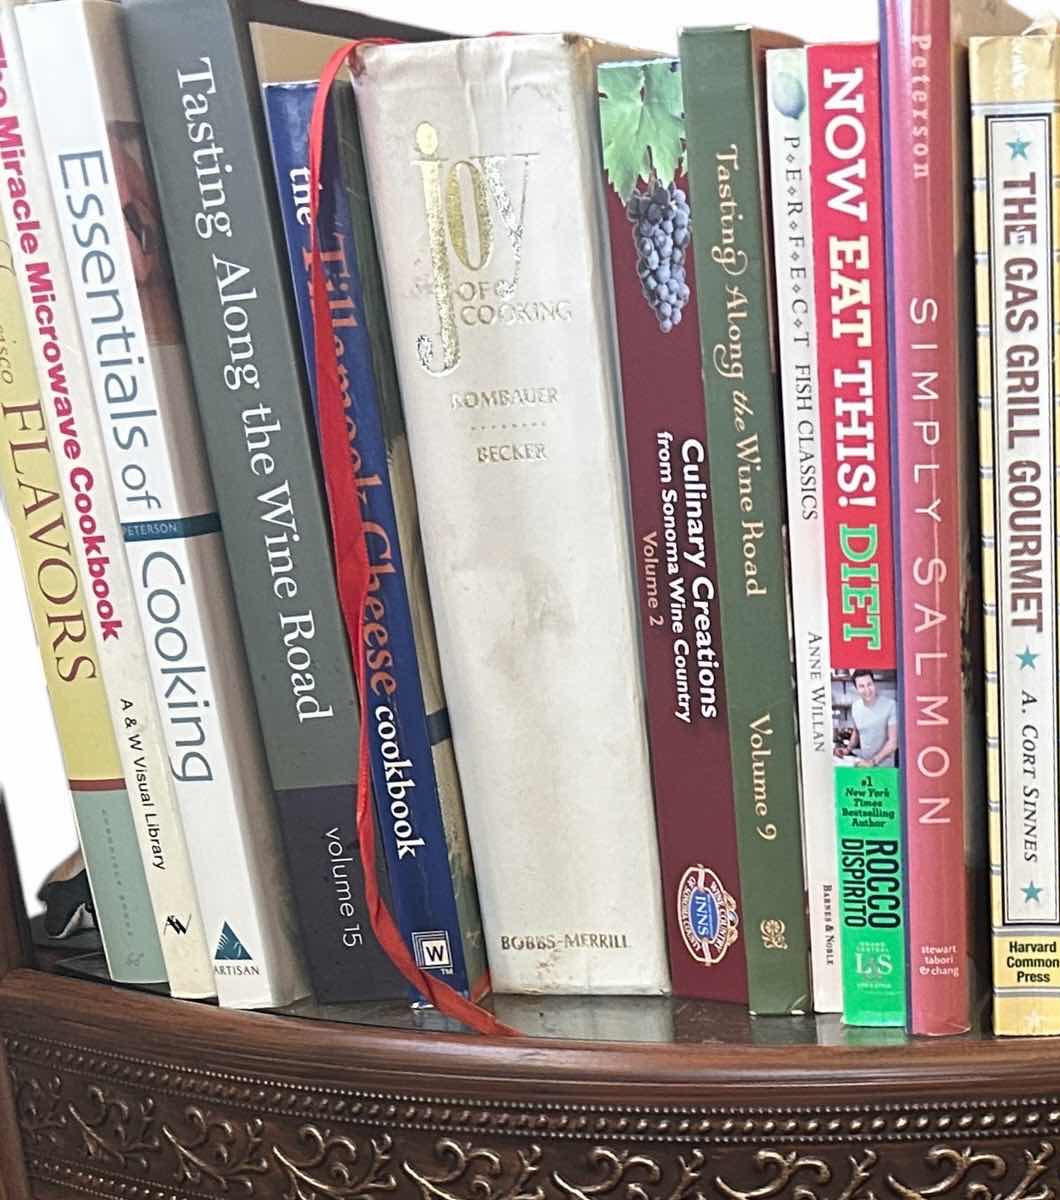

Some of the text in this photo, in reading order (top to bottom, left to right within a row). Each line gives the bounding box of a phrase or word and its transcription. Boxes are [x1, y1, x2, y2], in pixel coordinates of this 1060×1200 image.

[177, 56, 335, 724] Tasting Along the Wine Road
[450, 387, 560, 410] ROMBAUER
[711, 143, 768, 598] Tasting Along the Wine Road
[823, 67, 882, 651] NOW EAT THIS! DIET
[1002, 171, 1043, 633] THE GAS GRILL GOURMET
[58, 150, 214, 785] Essentials of Cooking
[476, 443, 547, 463] BECKER
[2, 402, 97, 683] FLAVORS
[640, 531, 665, 627] Volume 2
[656, 431, 692, 724] from Sonoma Wine Country
[681, 437, 720, 719] Culinary Creations
[910, 298, 952, 825] SIMPLY SALMON
[807, 631, 826, 753] ANNE WILLAN
[841, 808, 895, 820] Bestselling
[851, 818, 886, 829] Author
[695, 894, 709, 937] INNS
[841, 838, 867, 929] DISPIRITO
[864, 838, 901, 929] ROCCO
[500, 933, 630, 951] BOBBS-MERRILL
[1006, 956, 1060, 969] Common
[1009, 940, 1058, 954] Harvard
[1016, 971, 1051, 984] Press
